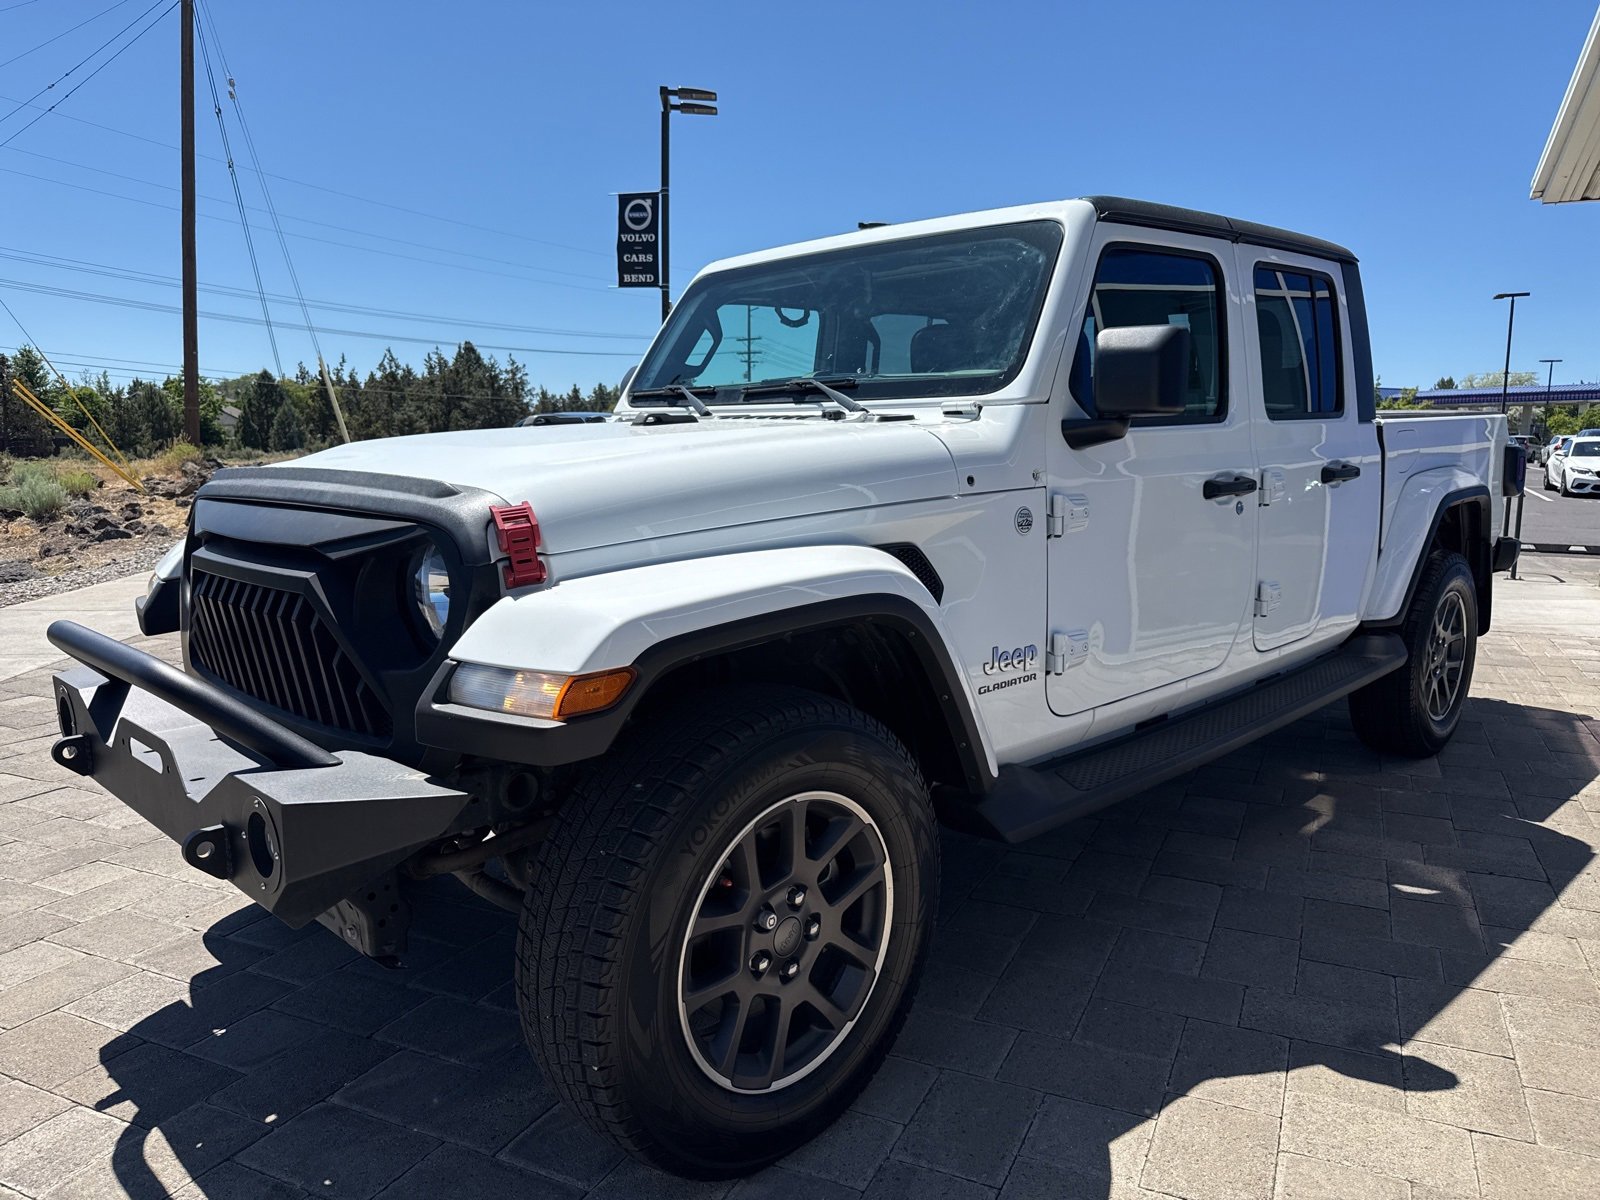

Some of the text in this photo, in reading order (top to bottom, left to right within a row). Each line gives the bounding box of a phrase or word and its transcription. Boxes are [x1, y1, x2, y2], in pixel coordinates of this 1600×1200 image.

[620, 233, 656, 242] VOLVO
[623, 253, 653, 262] CARS
[623, 274, 655, 283] BEND
[983, 644, 1038, 676] Jeep
[978, 673, 1037, 695] GLADIATOR
